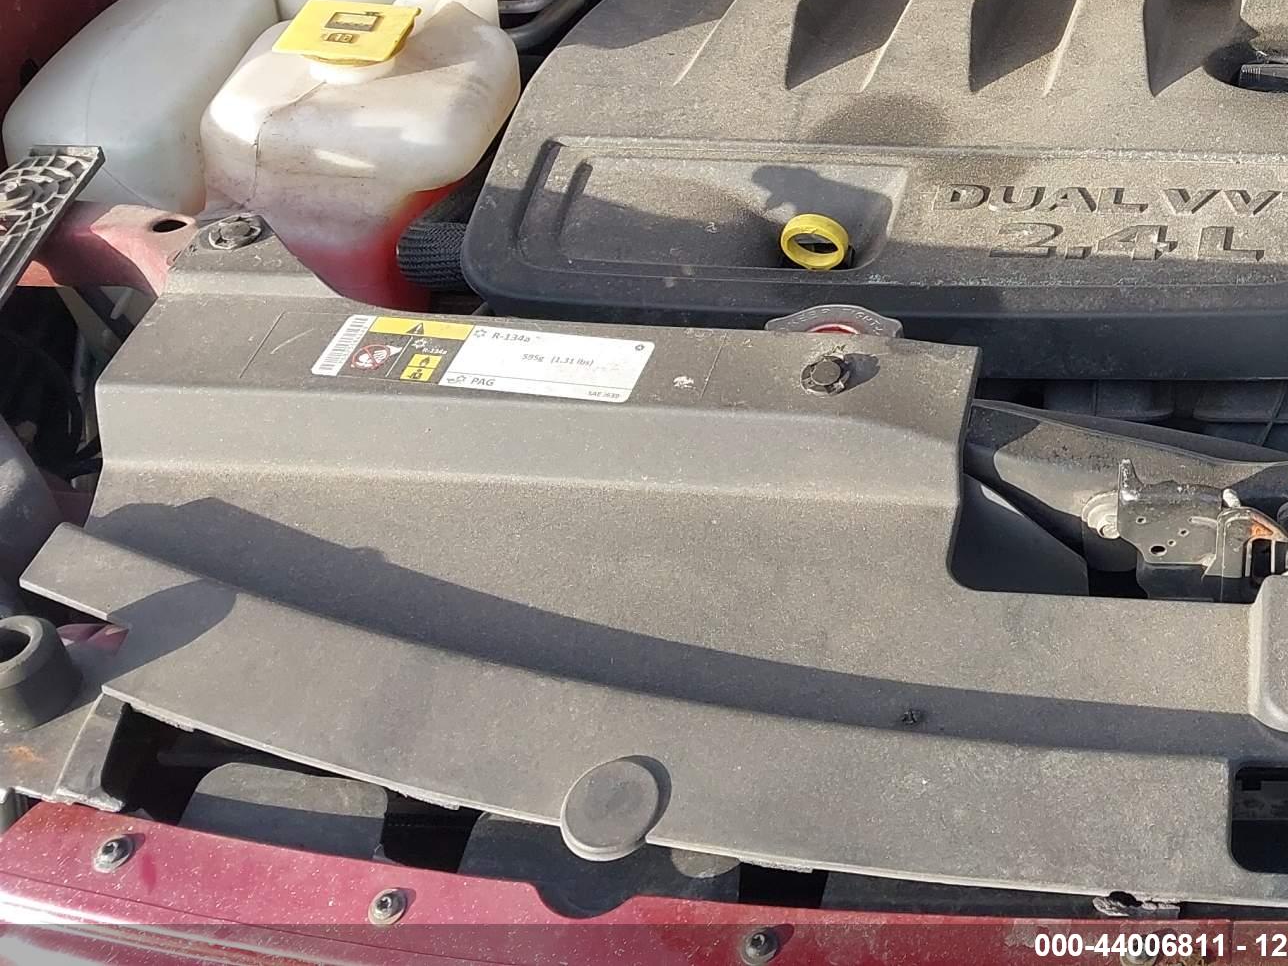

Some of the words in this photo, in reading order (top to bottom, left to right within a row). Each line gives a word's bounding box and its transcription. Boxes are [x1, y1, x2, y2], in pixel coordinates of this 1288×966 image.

[932, 183, 1149, 213] DUAL
[988, 221, 1266, 262] 2.4L
[491, 331, 532, 343] R-134a
[470, 377, 496, 387] PAG
